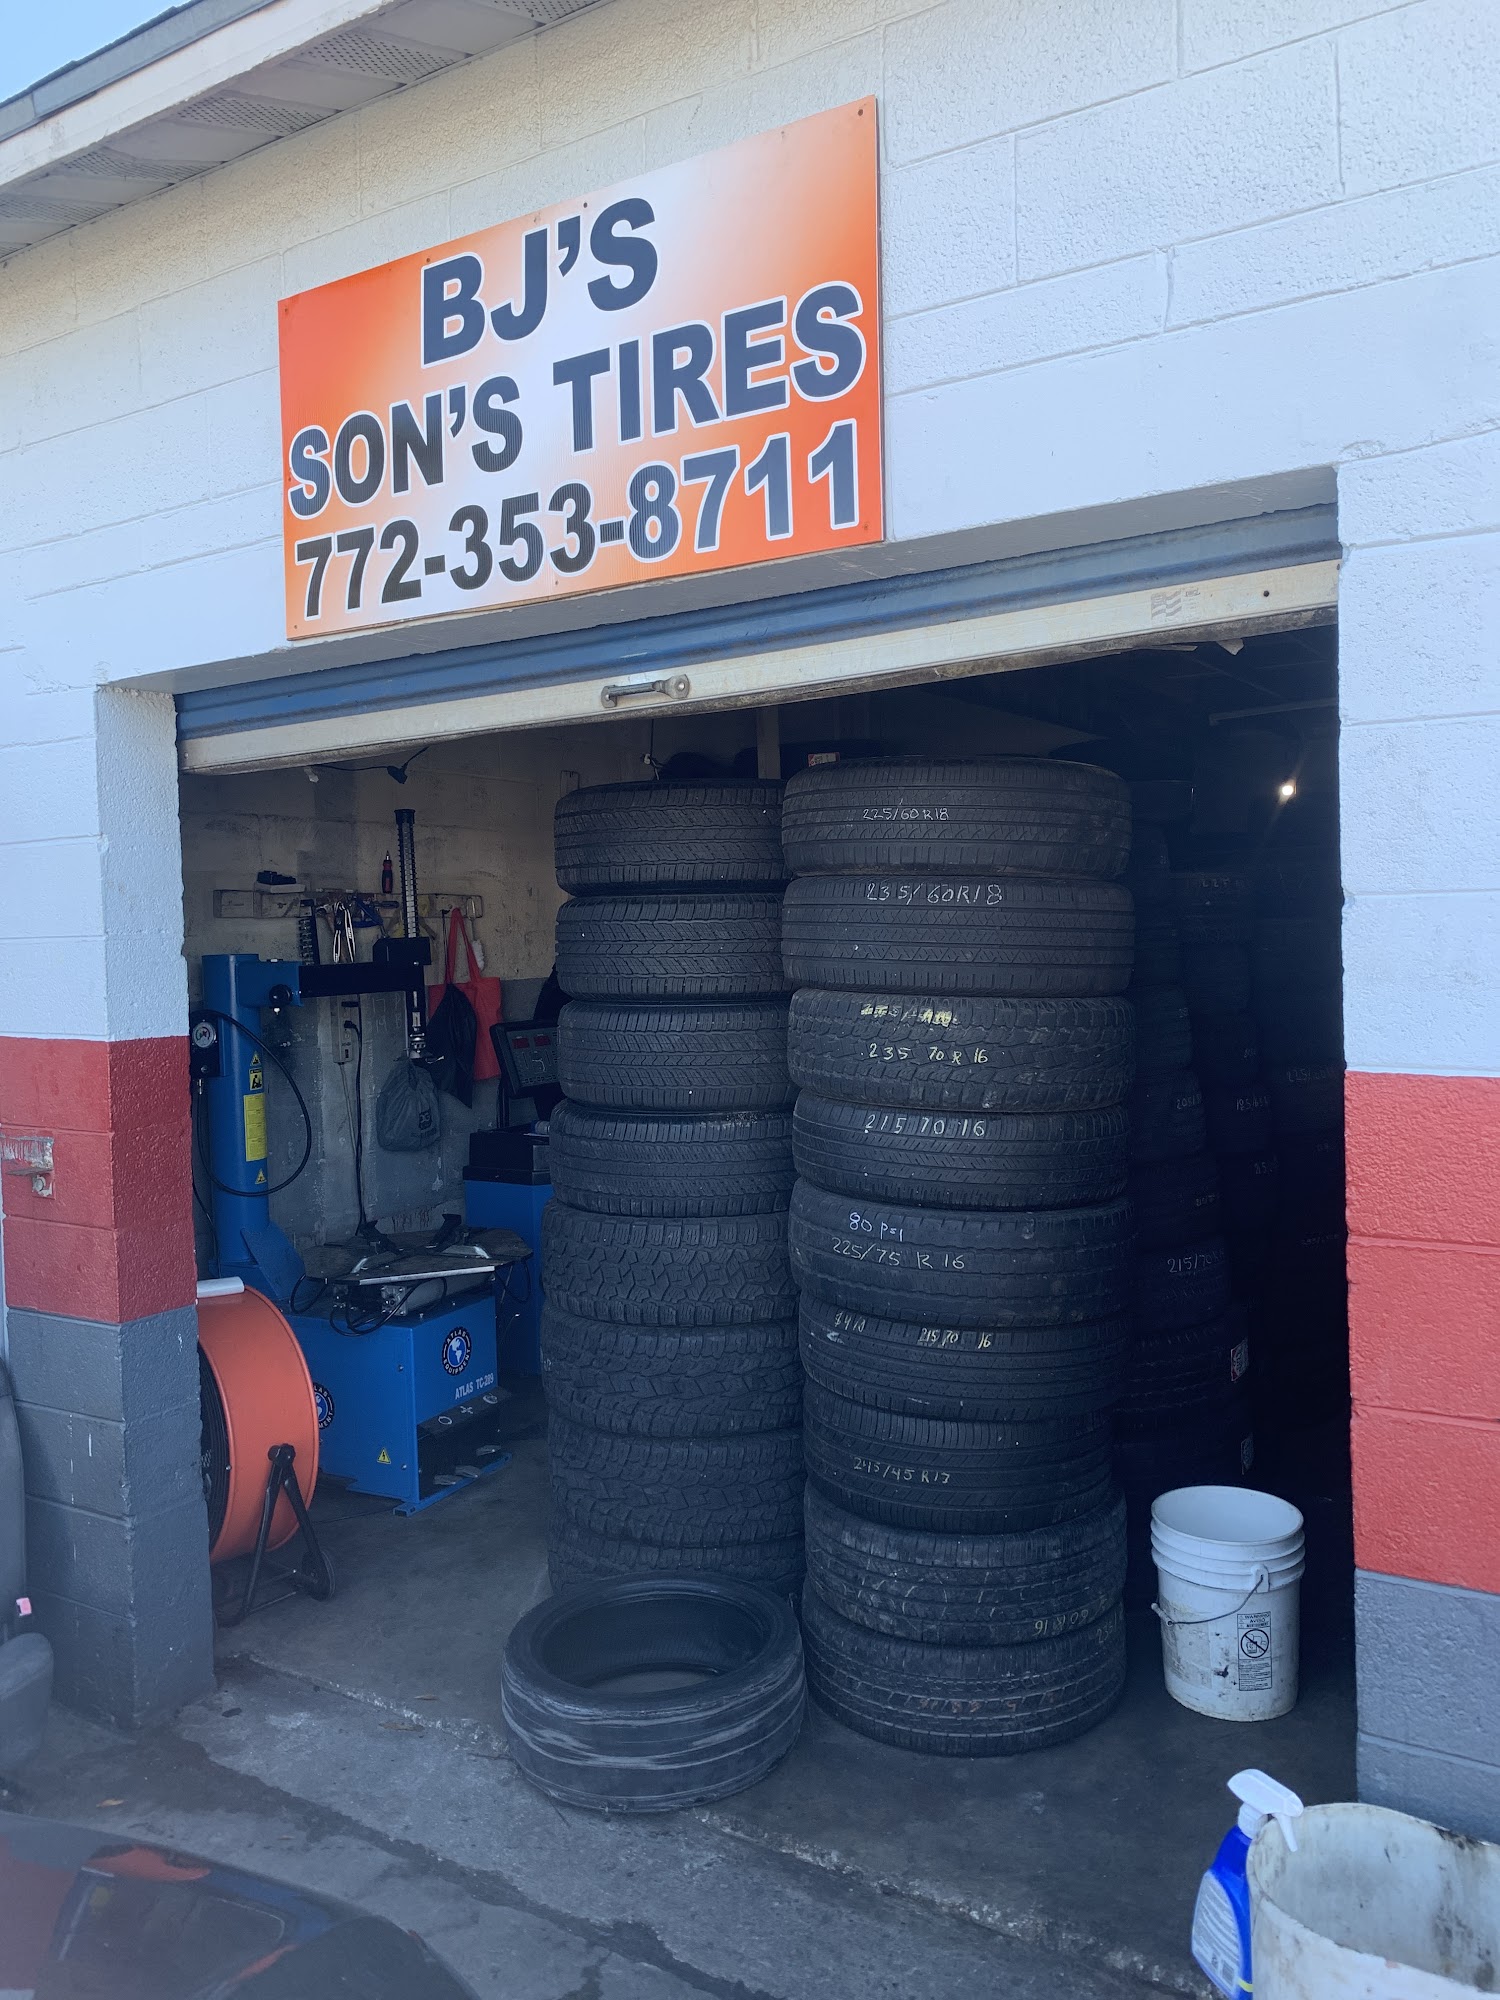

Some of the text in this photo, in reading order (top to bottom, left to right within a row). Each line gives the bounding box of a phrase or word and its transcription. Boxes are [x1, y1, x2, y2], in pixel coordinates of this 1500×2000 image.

[422, 197, 659, 368] BJ'S
[289, 281, 866, 518] SON'S TIRES
[296, 419, 858, 619] 772-353-8711
[869, 1043, 989, 1065] 235 70 R 16
[865, 1114, 985, 1137] 215 70 16
[849, 1212, 873, 1232] 80
[832, 1237, 965, 1270] 225/75 R 16
[446, 1329, 467, 1345] ATLAS
[917, 1327, 941, 1344] 215
[942, 1329, 959, 1347] 70
[978, 1332, 992, 1349] 16
[443, 1348, 471, 1375] EQUIPMENT
[455, 1381, 474, 1400] ATLAS
[1032, 1620, 1048, 1637] 16
